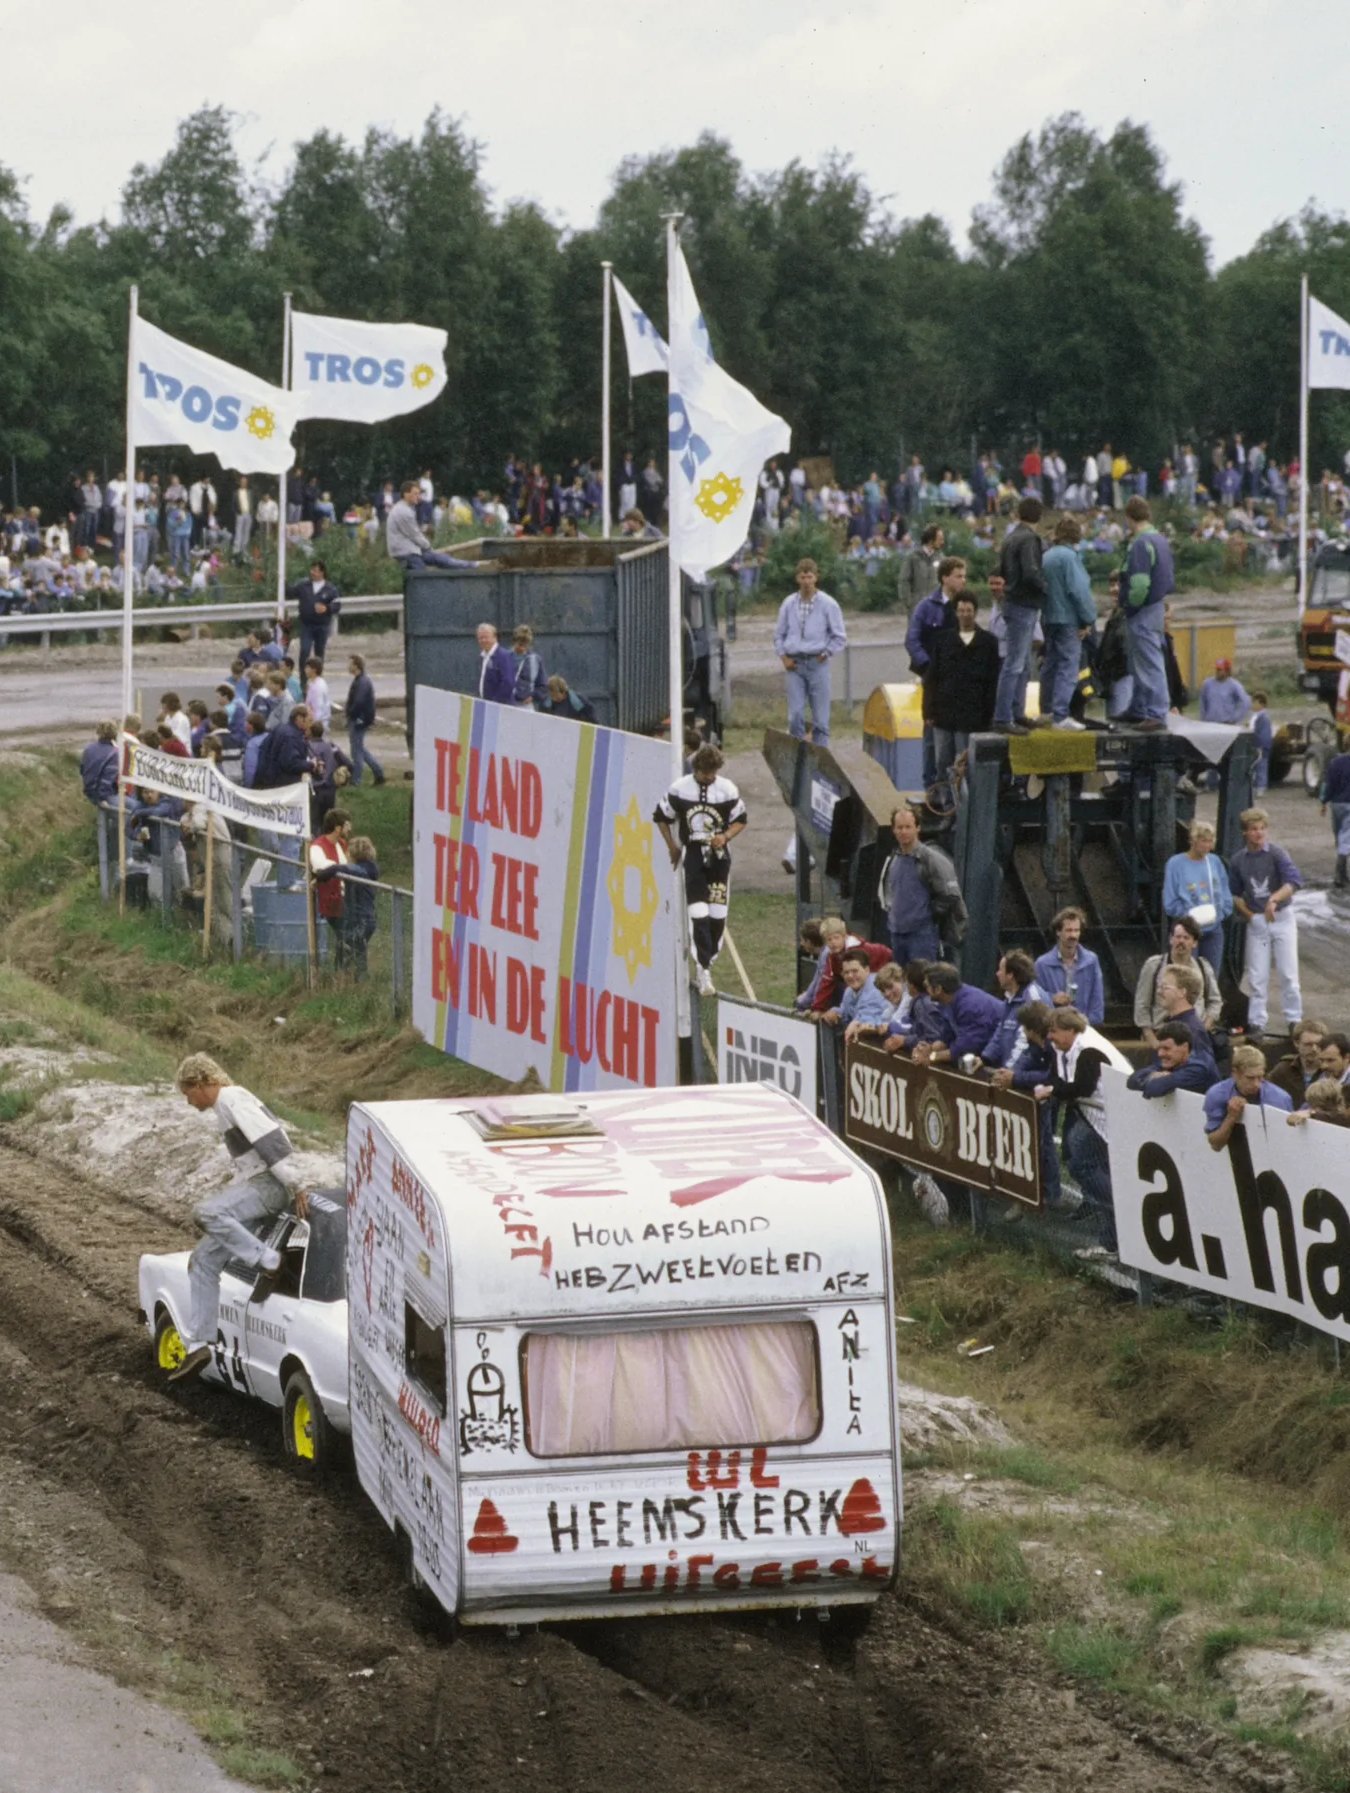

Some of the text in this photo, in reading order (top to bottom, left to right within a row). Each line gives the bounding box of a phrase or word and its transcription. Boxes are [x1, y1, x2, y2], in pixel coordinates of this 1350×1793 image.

[305, 351, 405, 388] TROS
[434, 737, 543, 840] TE LAND
[433, 832, 539, 941] TER ZEE
[431, 926, 660, 1088] EN IN DE LUCHT
[850, 1061, 1035, 1182] SKOL BIER
[548, 1490, 851, 1553] HEEMSKERK
[854, 1539, 872, 1553] NL
